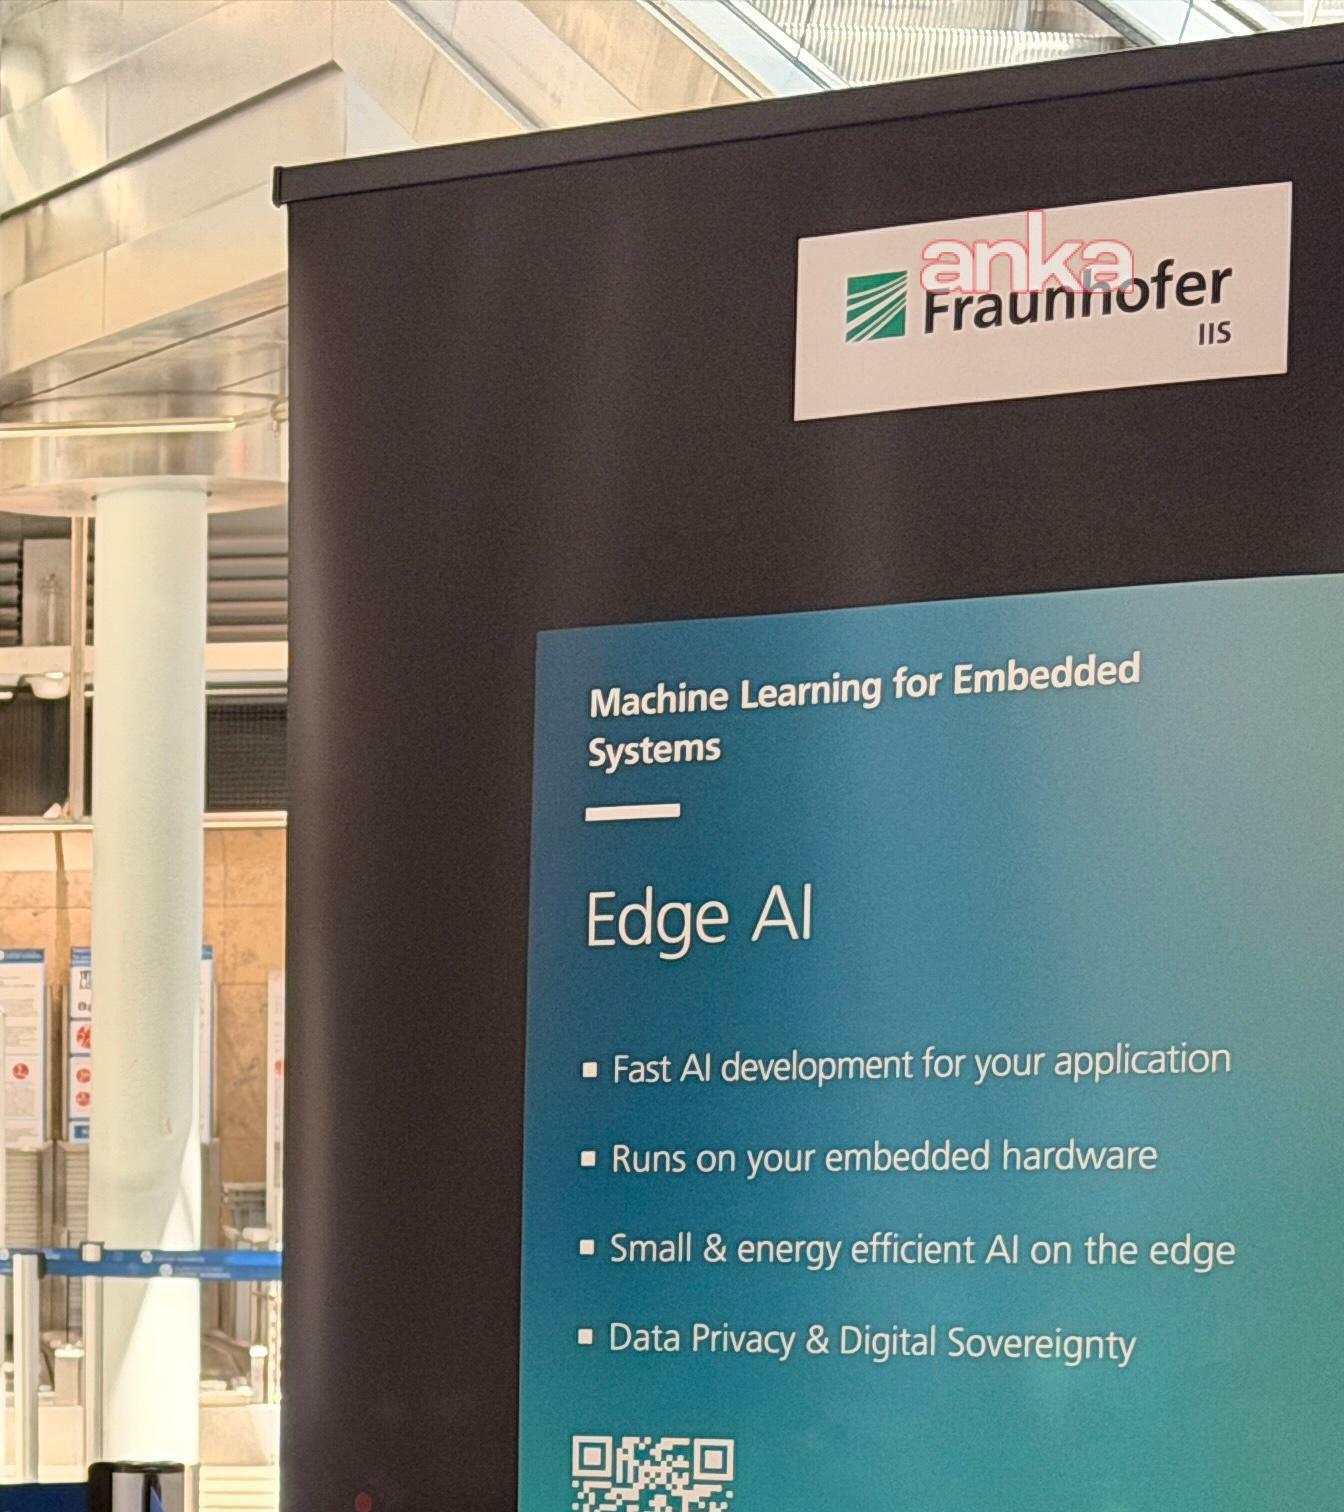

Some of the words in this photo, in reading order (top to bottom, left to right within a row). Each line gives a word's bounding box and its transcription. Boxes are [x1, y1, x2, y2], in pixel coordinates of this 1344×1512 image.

[924, 258, 1233, 335] Fraunhofer
[1198, 320, 1232, 346] IIS
[590, 682, 730, 719] Machine
[741, 671, 883, 710] Learning
[892, 666, 944, 699] for
[953, 650, 1141, 695] Embedded
[588, 736, 722, 775] Systems
[587, 885, 730, 961] Edge
[752, 883, 813, 942] AI
[613, 1054, 671, 1084] Fast
[680, 1053, 712, 1082] AI
[720, 1049, 914, 1088] development
[922, 1045, 966, 1079] for
[974, 1051, 1046, 1086] your
[1054, 1041, 1232, 1084] application
[612, 1143, 687, 1174] Runs
[696, 1149, 736, 1173] on
[746, 1148, 816, 1180] your
[824, 1138, 991, 1173] embedded
[1002, 1137, 1159, 1171] hardware
[610, 1231, 692, 1263] Small
[703, 1233, 727, 1263] &
[737, 1239, 843, 1272] energy
[850, 1230, 976, 1265] efficient
[985, 1233, 1019, 1265] AI
[1029, 1240, 1072, 1266] on
[1083, 1231, 1139, 1266] the
[1149, 1232, 1237, 1274] edge
[610, 1321, 681, 1352] Data
[692, 1322, 797, 1362] Privacy
[805, 1323, 830, 1355] &
[840, 1323, 937, 1364] Digital
[947, 1326, 1138, 1369] Sovereignty
